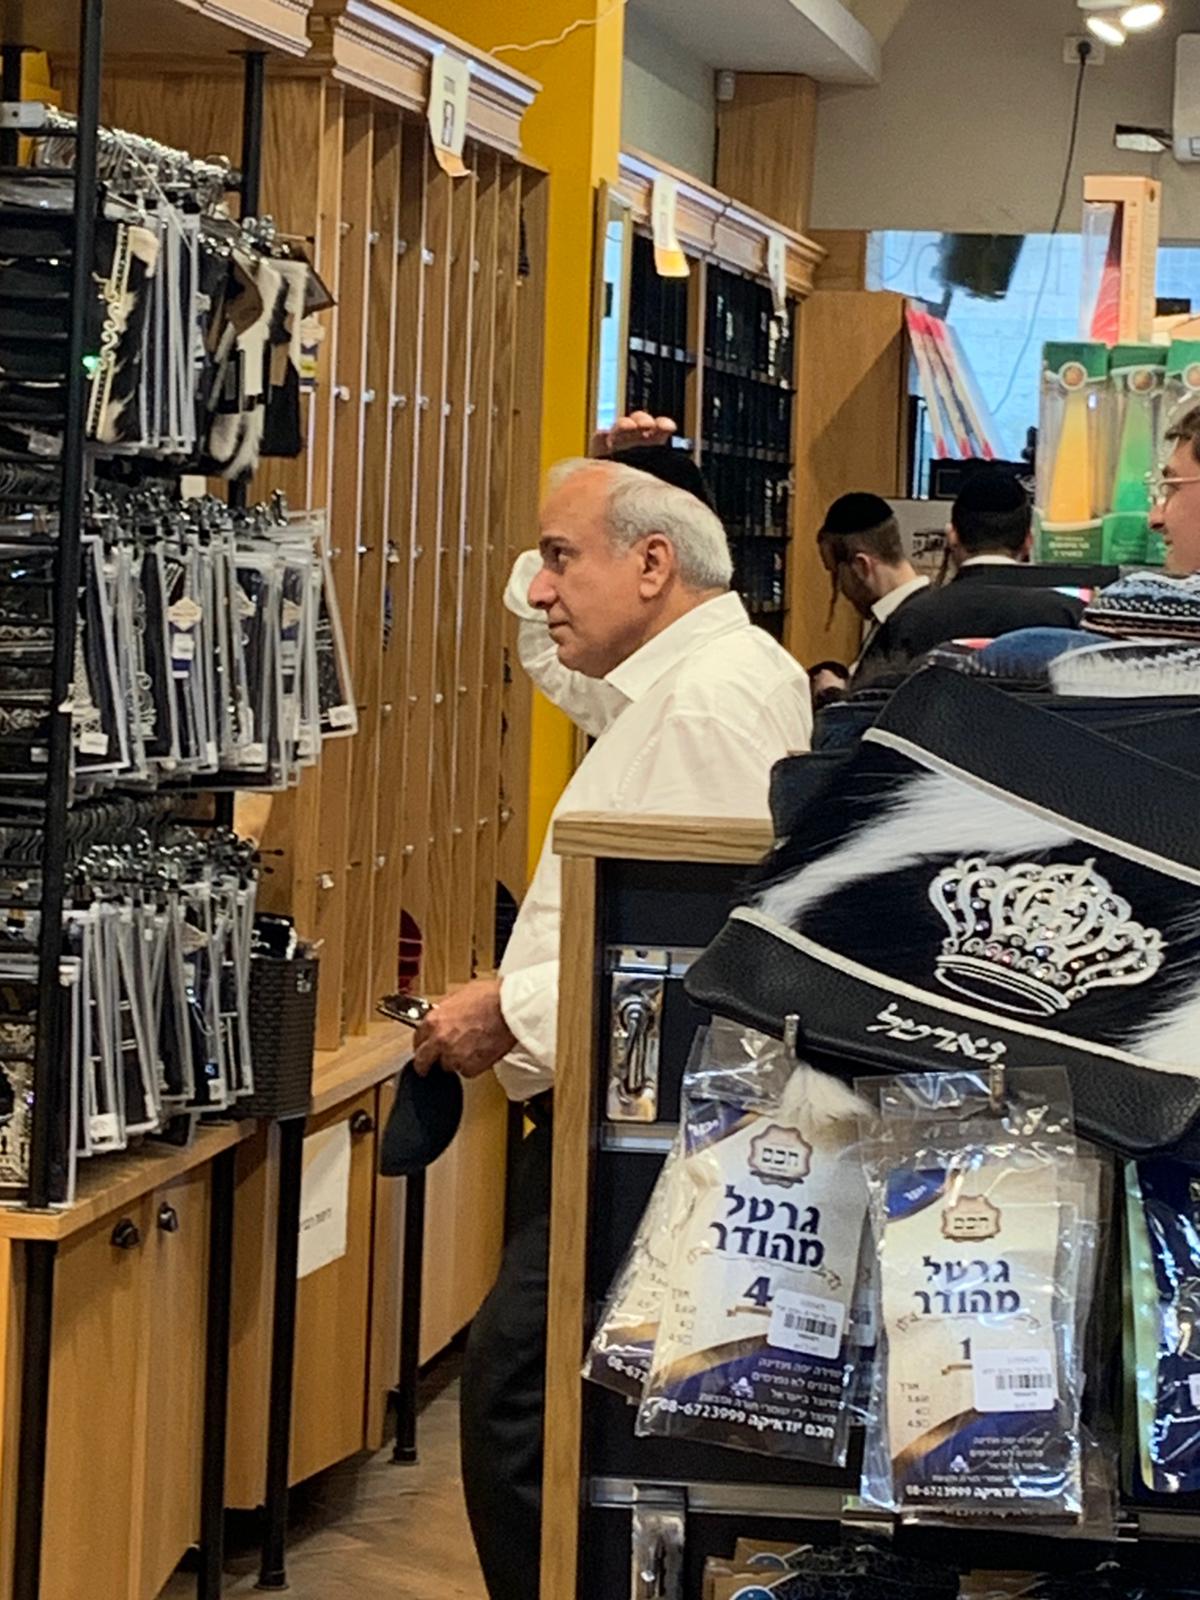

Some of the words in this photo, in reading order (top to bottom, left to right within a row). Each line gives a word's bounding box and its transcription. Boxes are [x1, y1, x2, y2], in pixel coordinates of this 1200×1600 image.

[762, 1147, 799, 1167] חכם
[725, 1184, 821, 1235] גרטל
[710, 1221, 825, 1267] מהודר
[922, 1255, 1010, 1284] גרטל
[742, 1276, 774, 1307] 4
[914, 1289, 1021, 1314] מהודר
[960, 1336, 972, 1360] 1
[660, 1397, 746, 1423] 08-6723999
[803, 1424, 834, 1439] חכם
